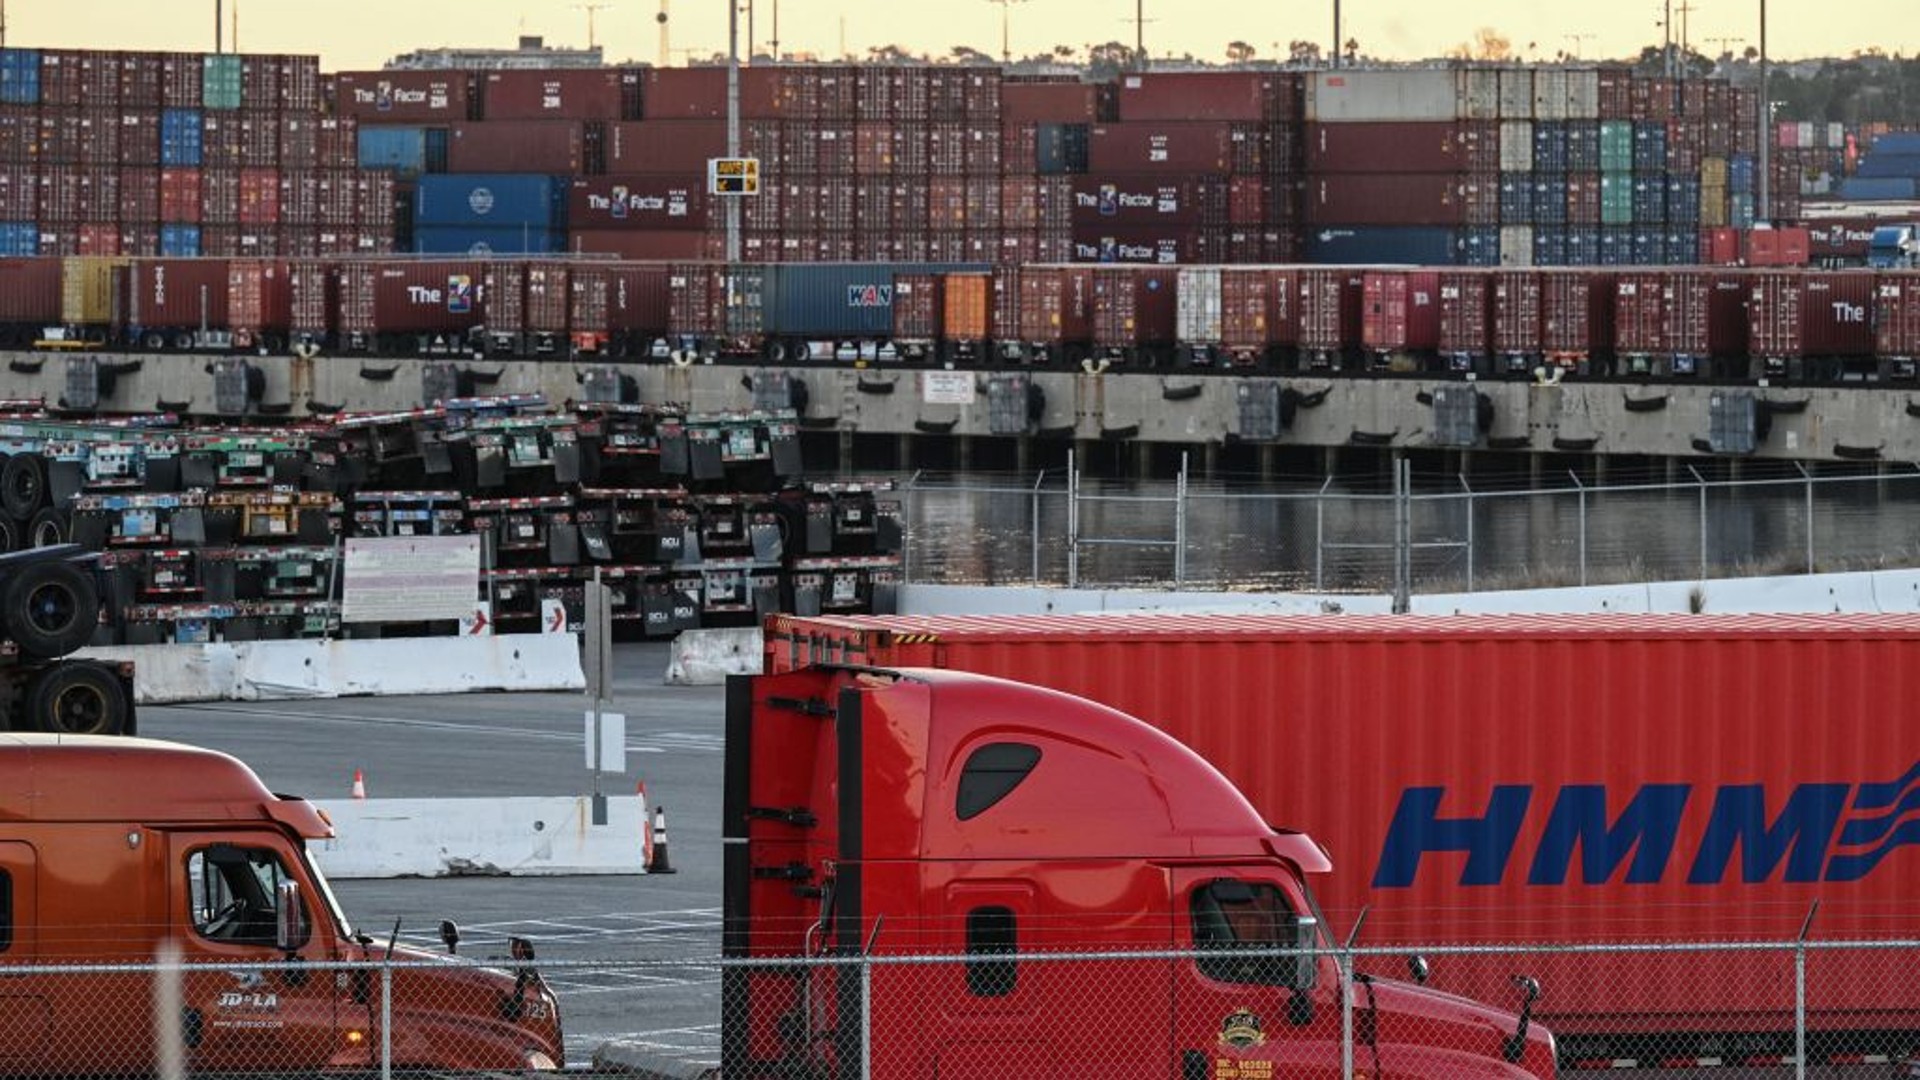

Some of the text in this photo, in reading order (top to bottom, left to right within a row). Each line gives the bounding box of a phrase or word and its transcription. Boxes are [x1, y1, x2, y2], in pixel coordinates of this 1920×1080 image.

[354, 88, 375, 102] The
[588, 194, 609, 209] The
[1075, 192, 1098, 207] The
[1075, 244, 1098, 258] The
[407, 285, 441, 304] The
[1832, 301, 1864, 323] The
[1371, 783, 1851, 888] HMM
